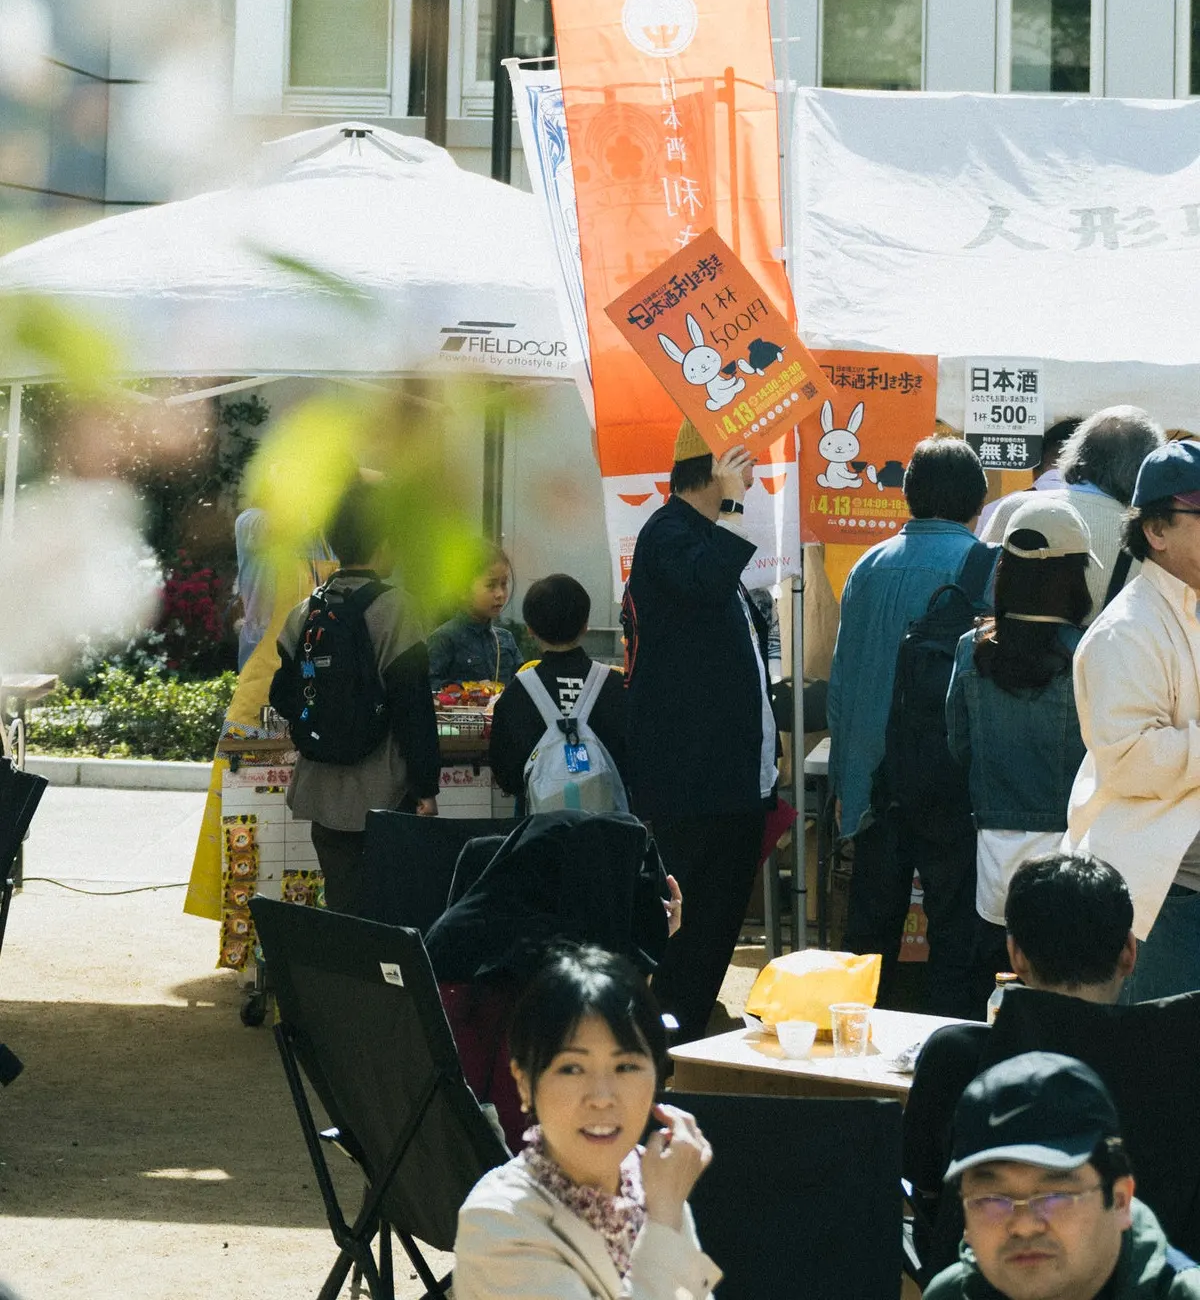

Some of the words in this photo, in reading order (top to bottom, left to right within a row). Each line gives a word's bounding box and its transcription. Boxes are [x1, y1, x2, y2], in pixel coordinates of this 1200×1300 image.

[961, 204, 1200, 251] 人形
[709, 298, 769, 351] 500円
[468, 336, 568, 357] FIELDOOR
[439, 353, 486, 364] Powered
[490, 355, 503, 367] by
[971, 367, 1039, 393] 日本酒
[721, 402, 757, 435] 4.13
[973, 412, 987, 422] 1杯
[991, 405, 1037, 424] 500円
[979, 443, 1029, 461] 無料
[818, 495, 851, 516] 4.13
